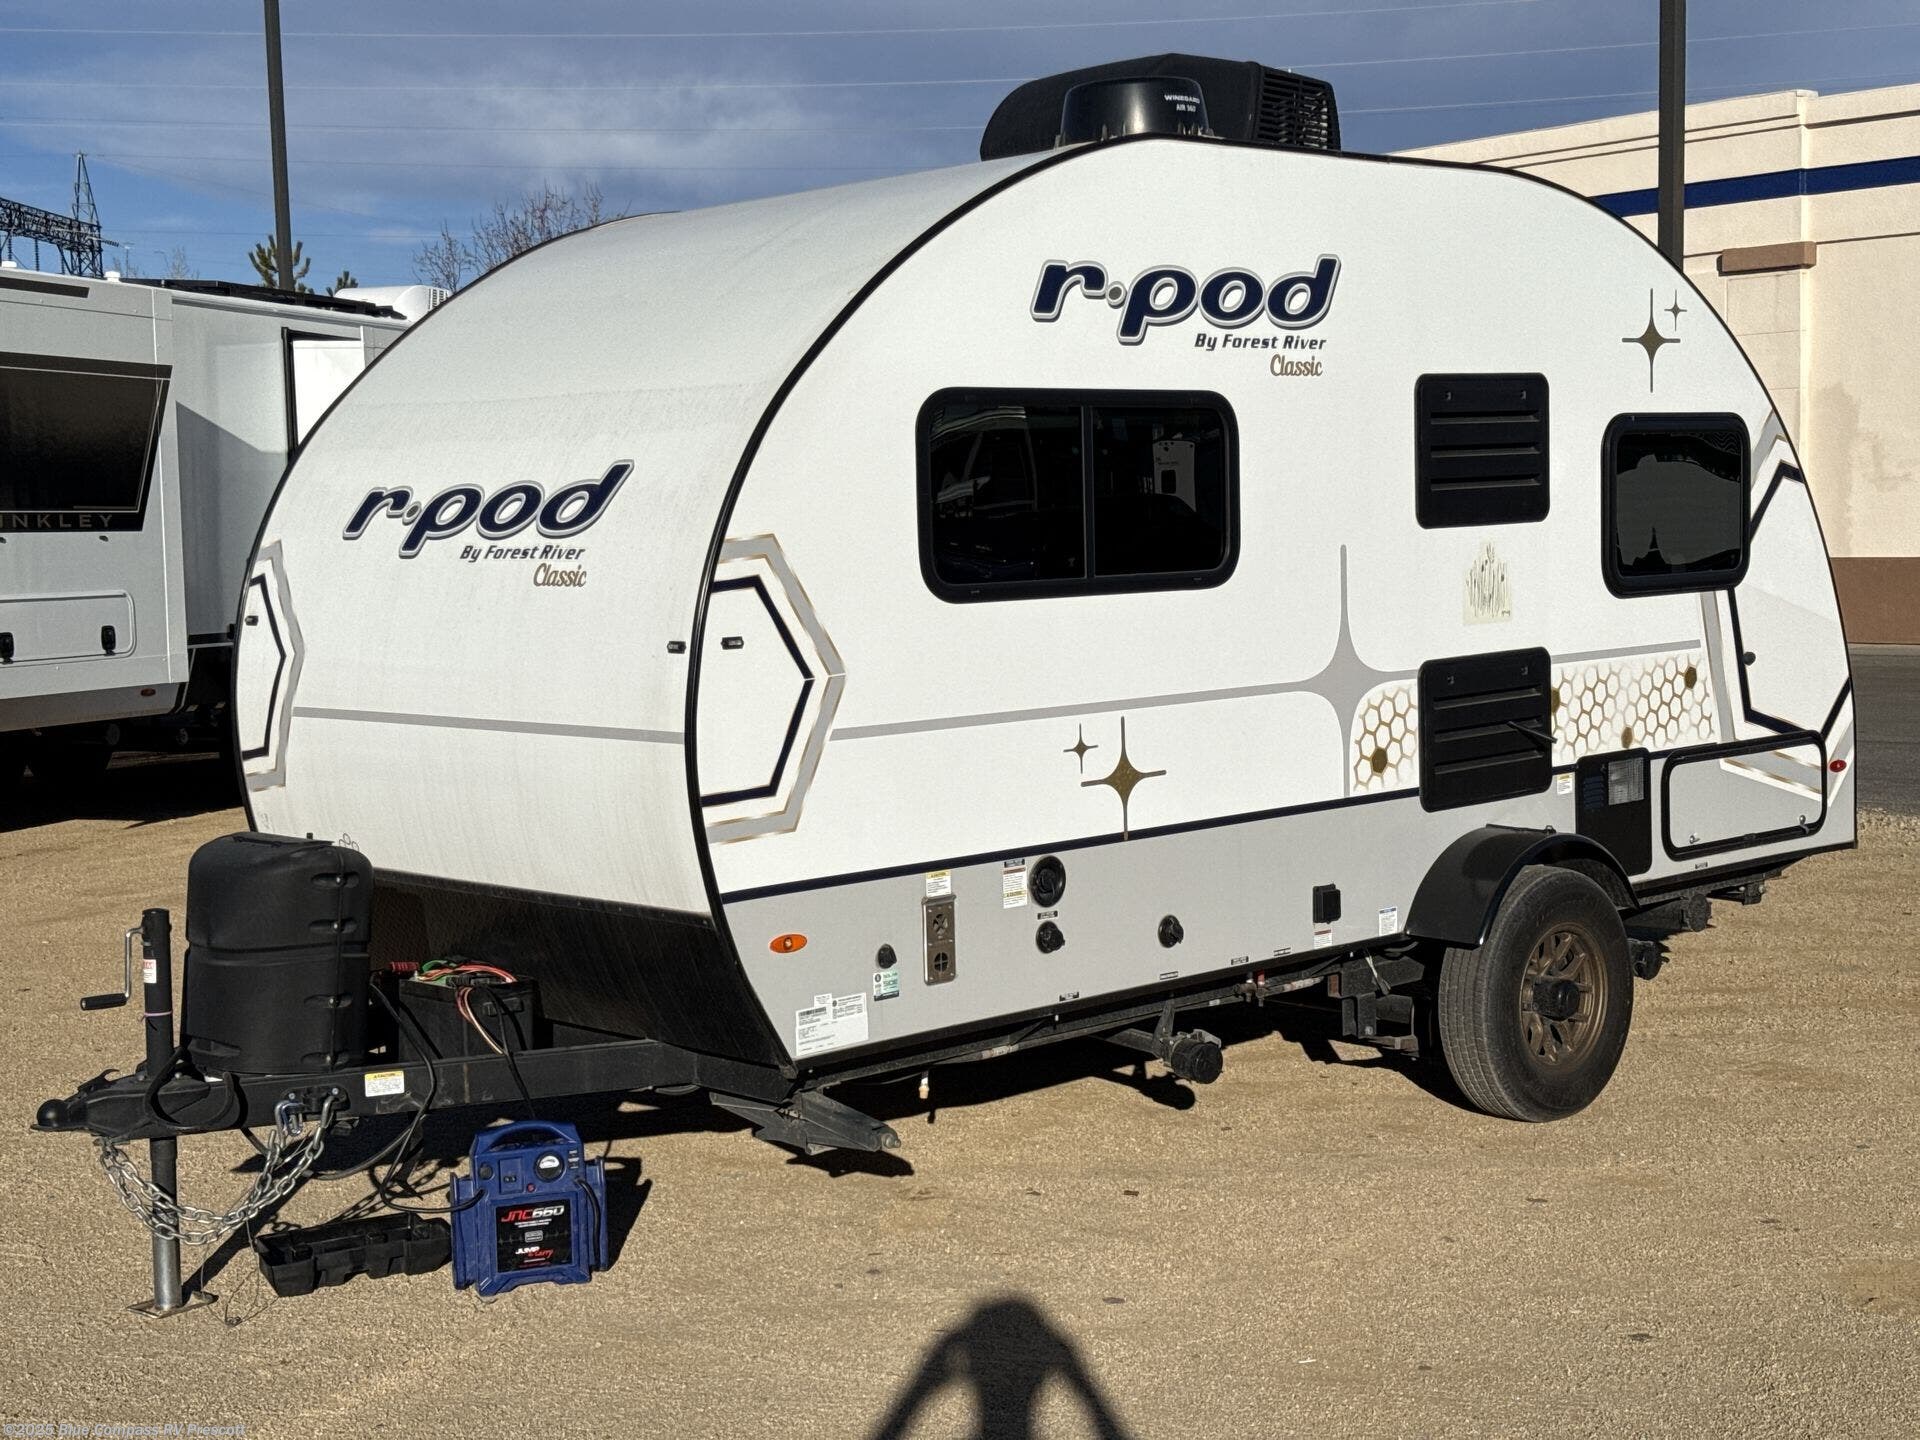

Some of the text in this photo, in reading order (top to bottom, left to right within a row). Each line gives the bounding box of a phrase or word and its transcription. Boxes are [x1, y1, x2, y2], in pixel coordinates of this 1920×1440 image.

[1194, 333, 1327, 351] By Forest River
[1270, 354, 1323, 377] Classic
[460, 545, 586, 563] By Forest River
[533, 563, 587, 587] Classic
[501, 1205, 564, 1222] JNC660
